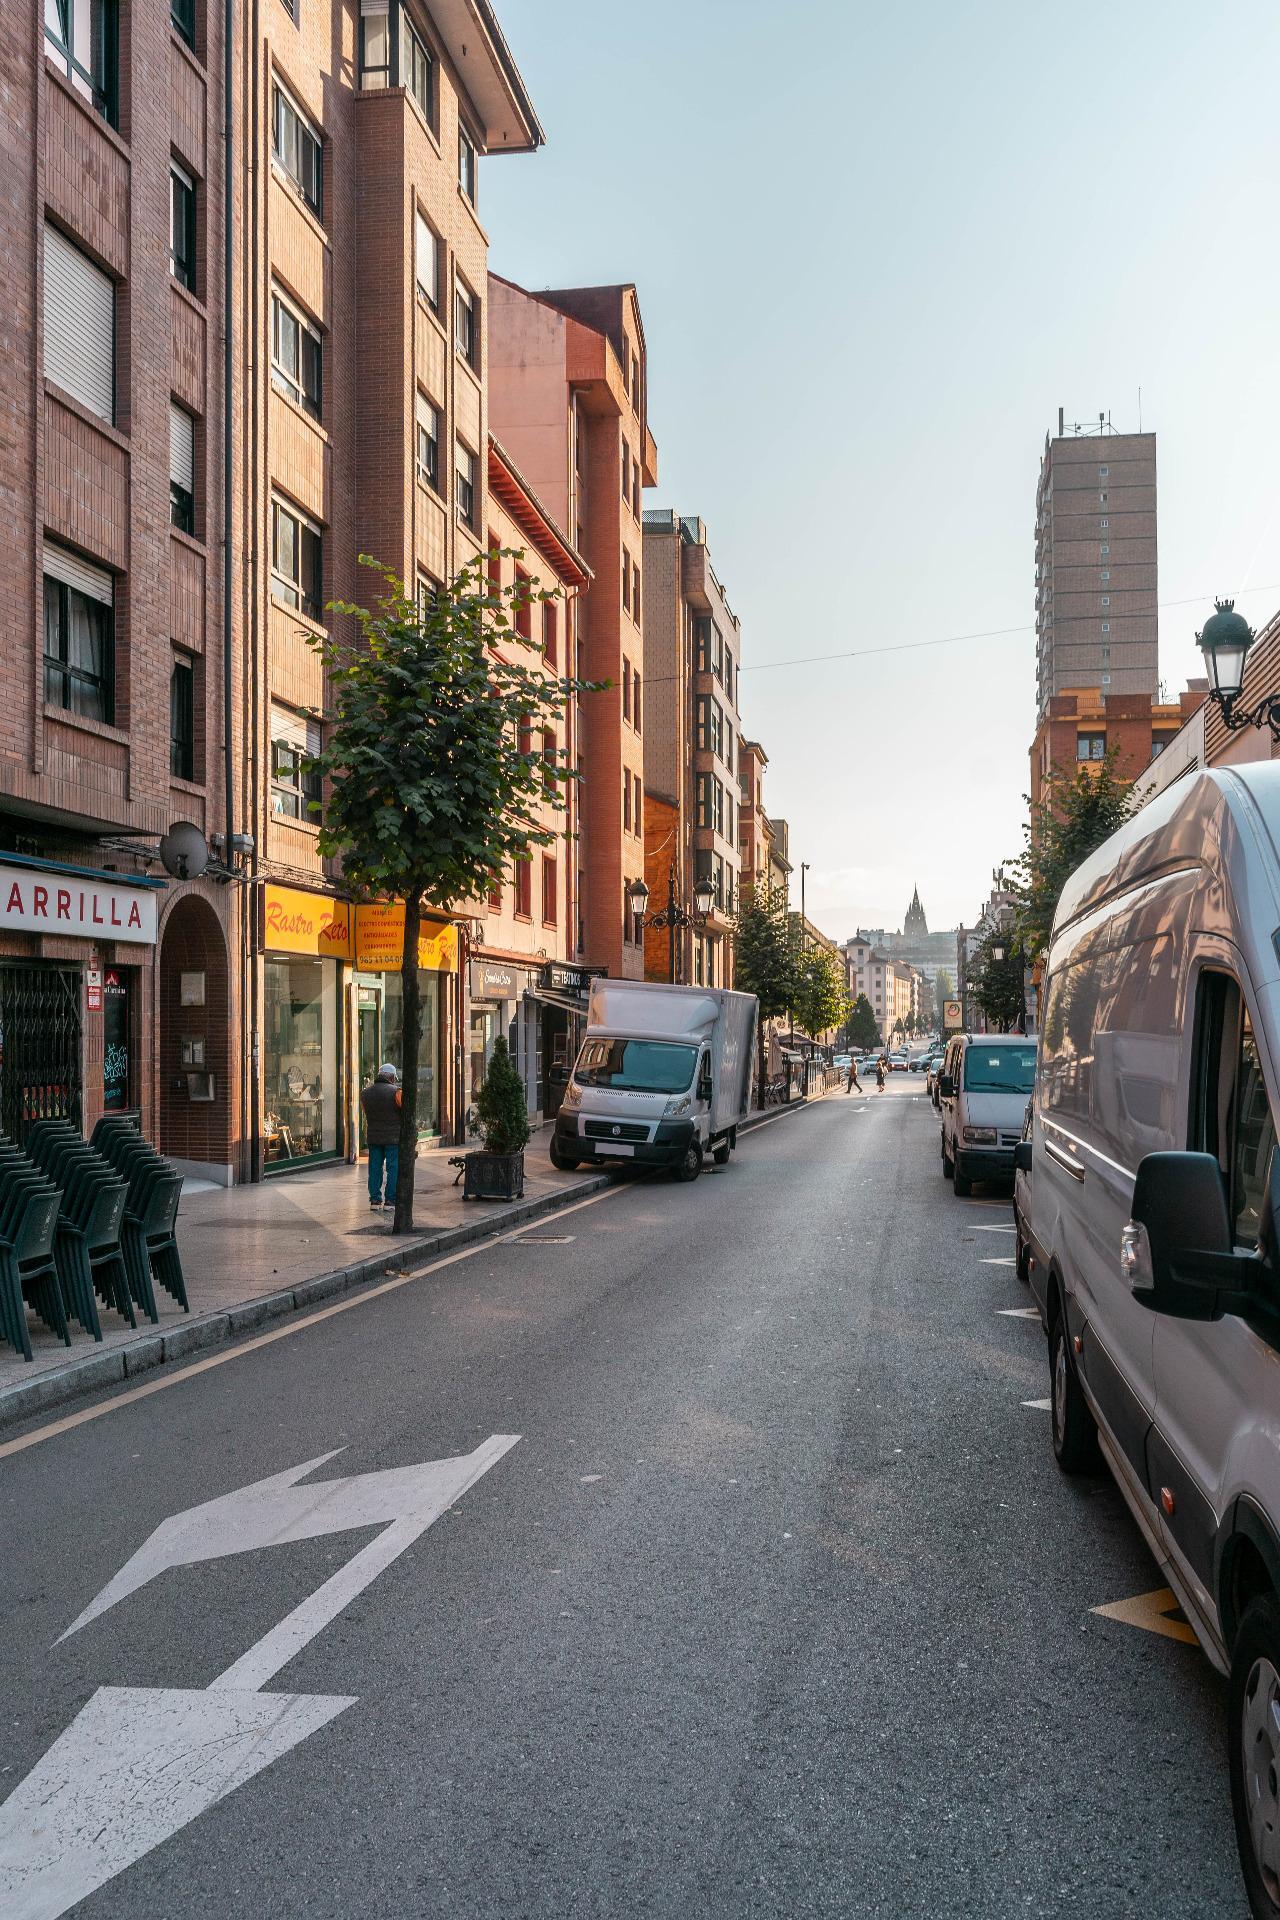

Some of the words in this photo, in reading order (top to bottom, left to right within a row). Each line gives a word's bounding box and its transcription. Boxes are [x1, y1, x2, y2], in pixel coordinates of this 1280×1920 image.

[6, 881, 142, 929] ARRILLA
[266, 901, 314, 936] Rastro
[319, 912, 348, 942] Reto
[359, 955, 373, 964] 985
